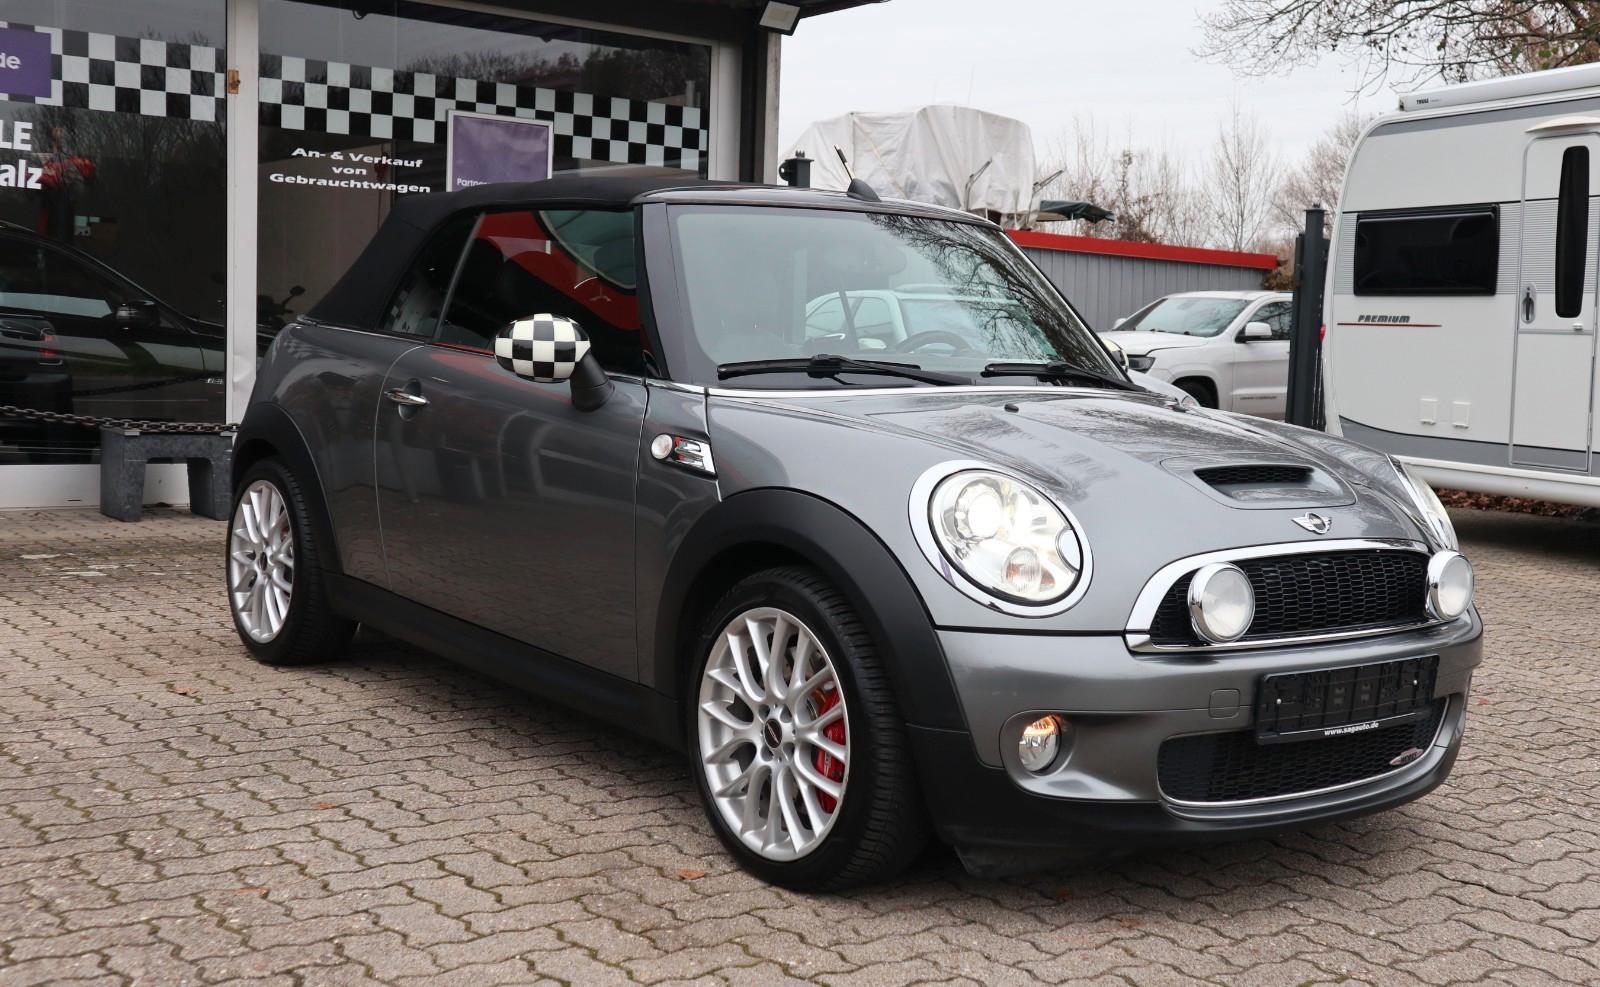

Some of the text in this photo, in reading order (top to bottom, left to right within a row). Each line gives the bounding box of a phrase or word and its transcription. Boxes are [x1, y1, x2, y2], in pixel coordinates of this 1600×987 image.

[0, 119, 33, 151] LE
[291, 147, 424, 168] An- & Verkauf
[0, 159, 43, 190] alz
[331, 166, 368, 176] von
[269, 173, 432, 194] Gebrauchtwagen
[456, 177, 489, 187] Partn
[1357, 314, 1411, 323] PREMIUM
[1324, 721, 1379, 736] www.sagauto.de
